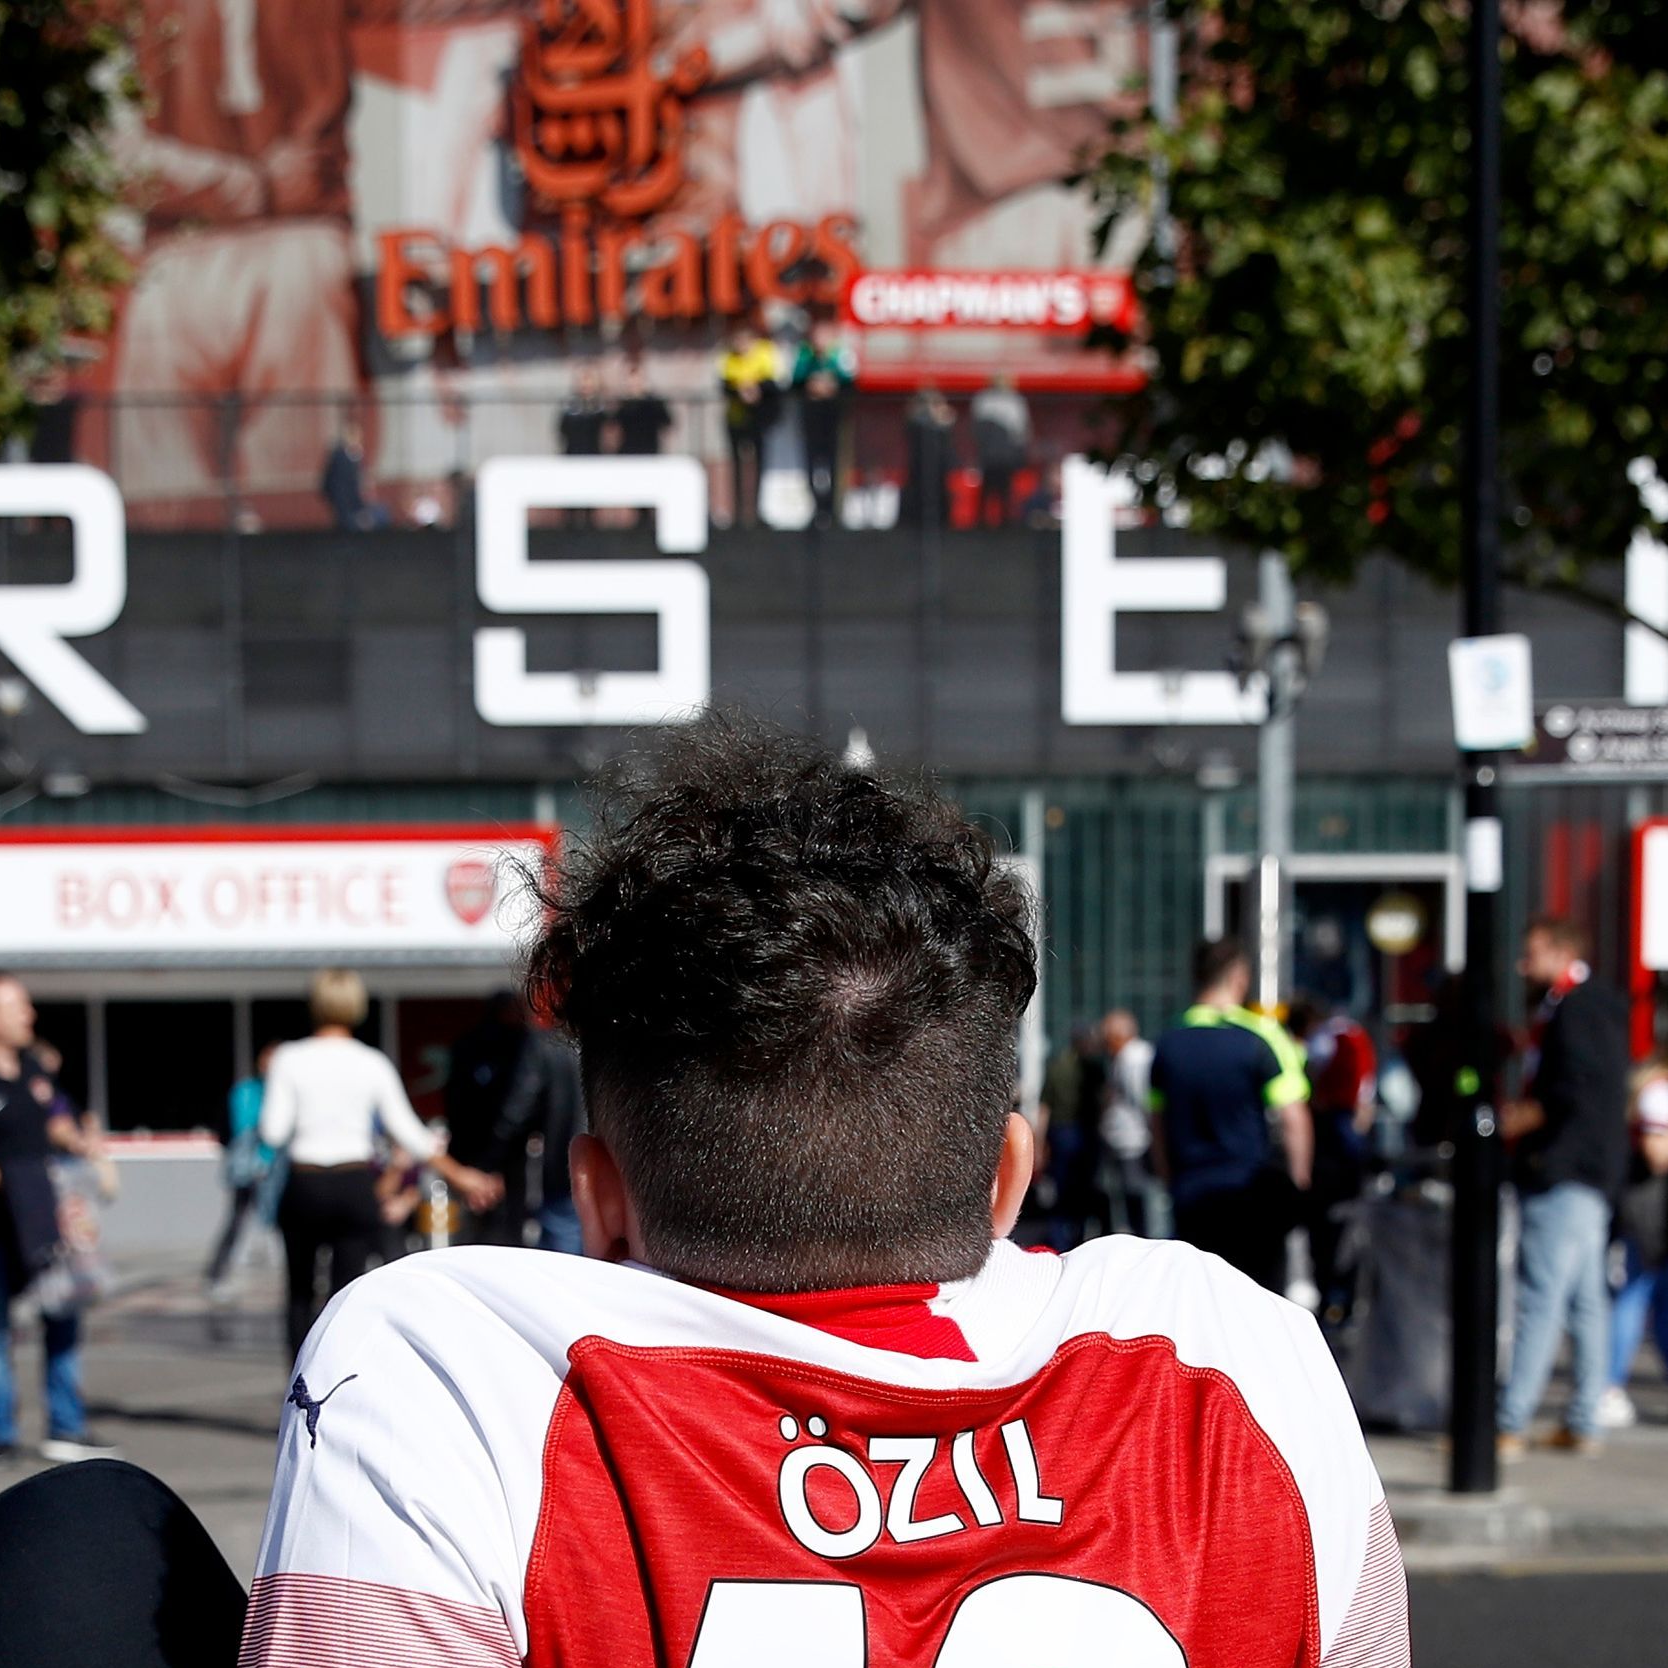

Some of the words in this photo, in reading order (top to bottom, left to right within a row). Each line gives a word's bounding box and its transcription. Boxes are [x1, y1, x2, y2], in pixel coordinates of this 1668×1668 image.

[375, 213, 860, 337] Emirates
[851, 273, 1089, 326] CHAPMAN'S
[54, 868, 184, 930] BOX
[200, 866, 410, 930] OFFICE
[777, 1414, 1064, 1560] ÖZIL
